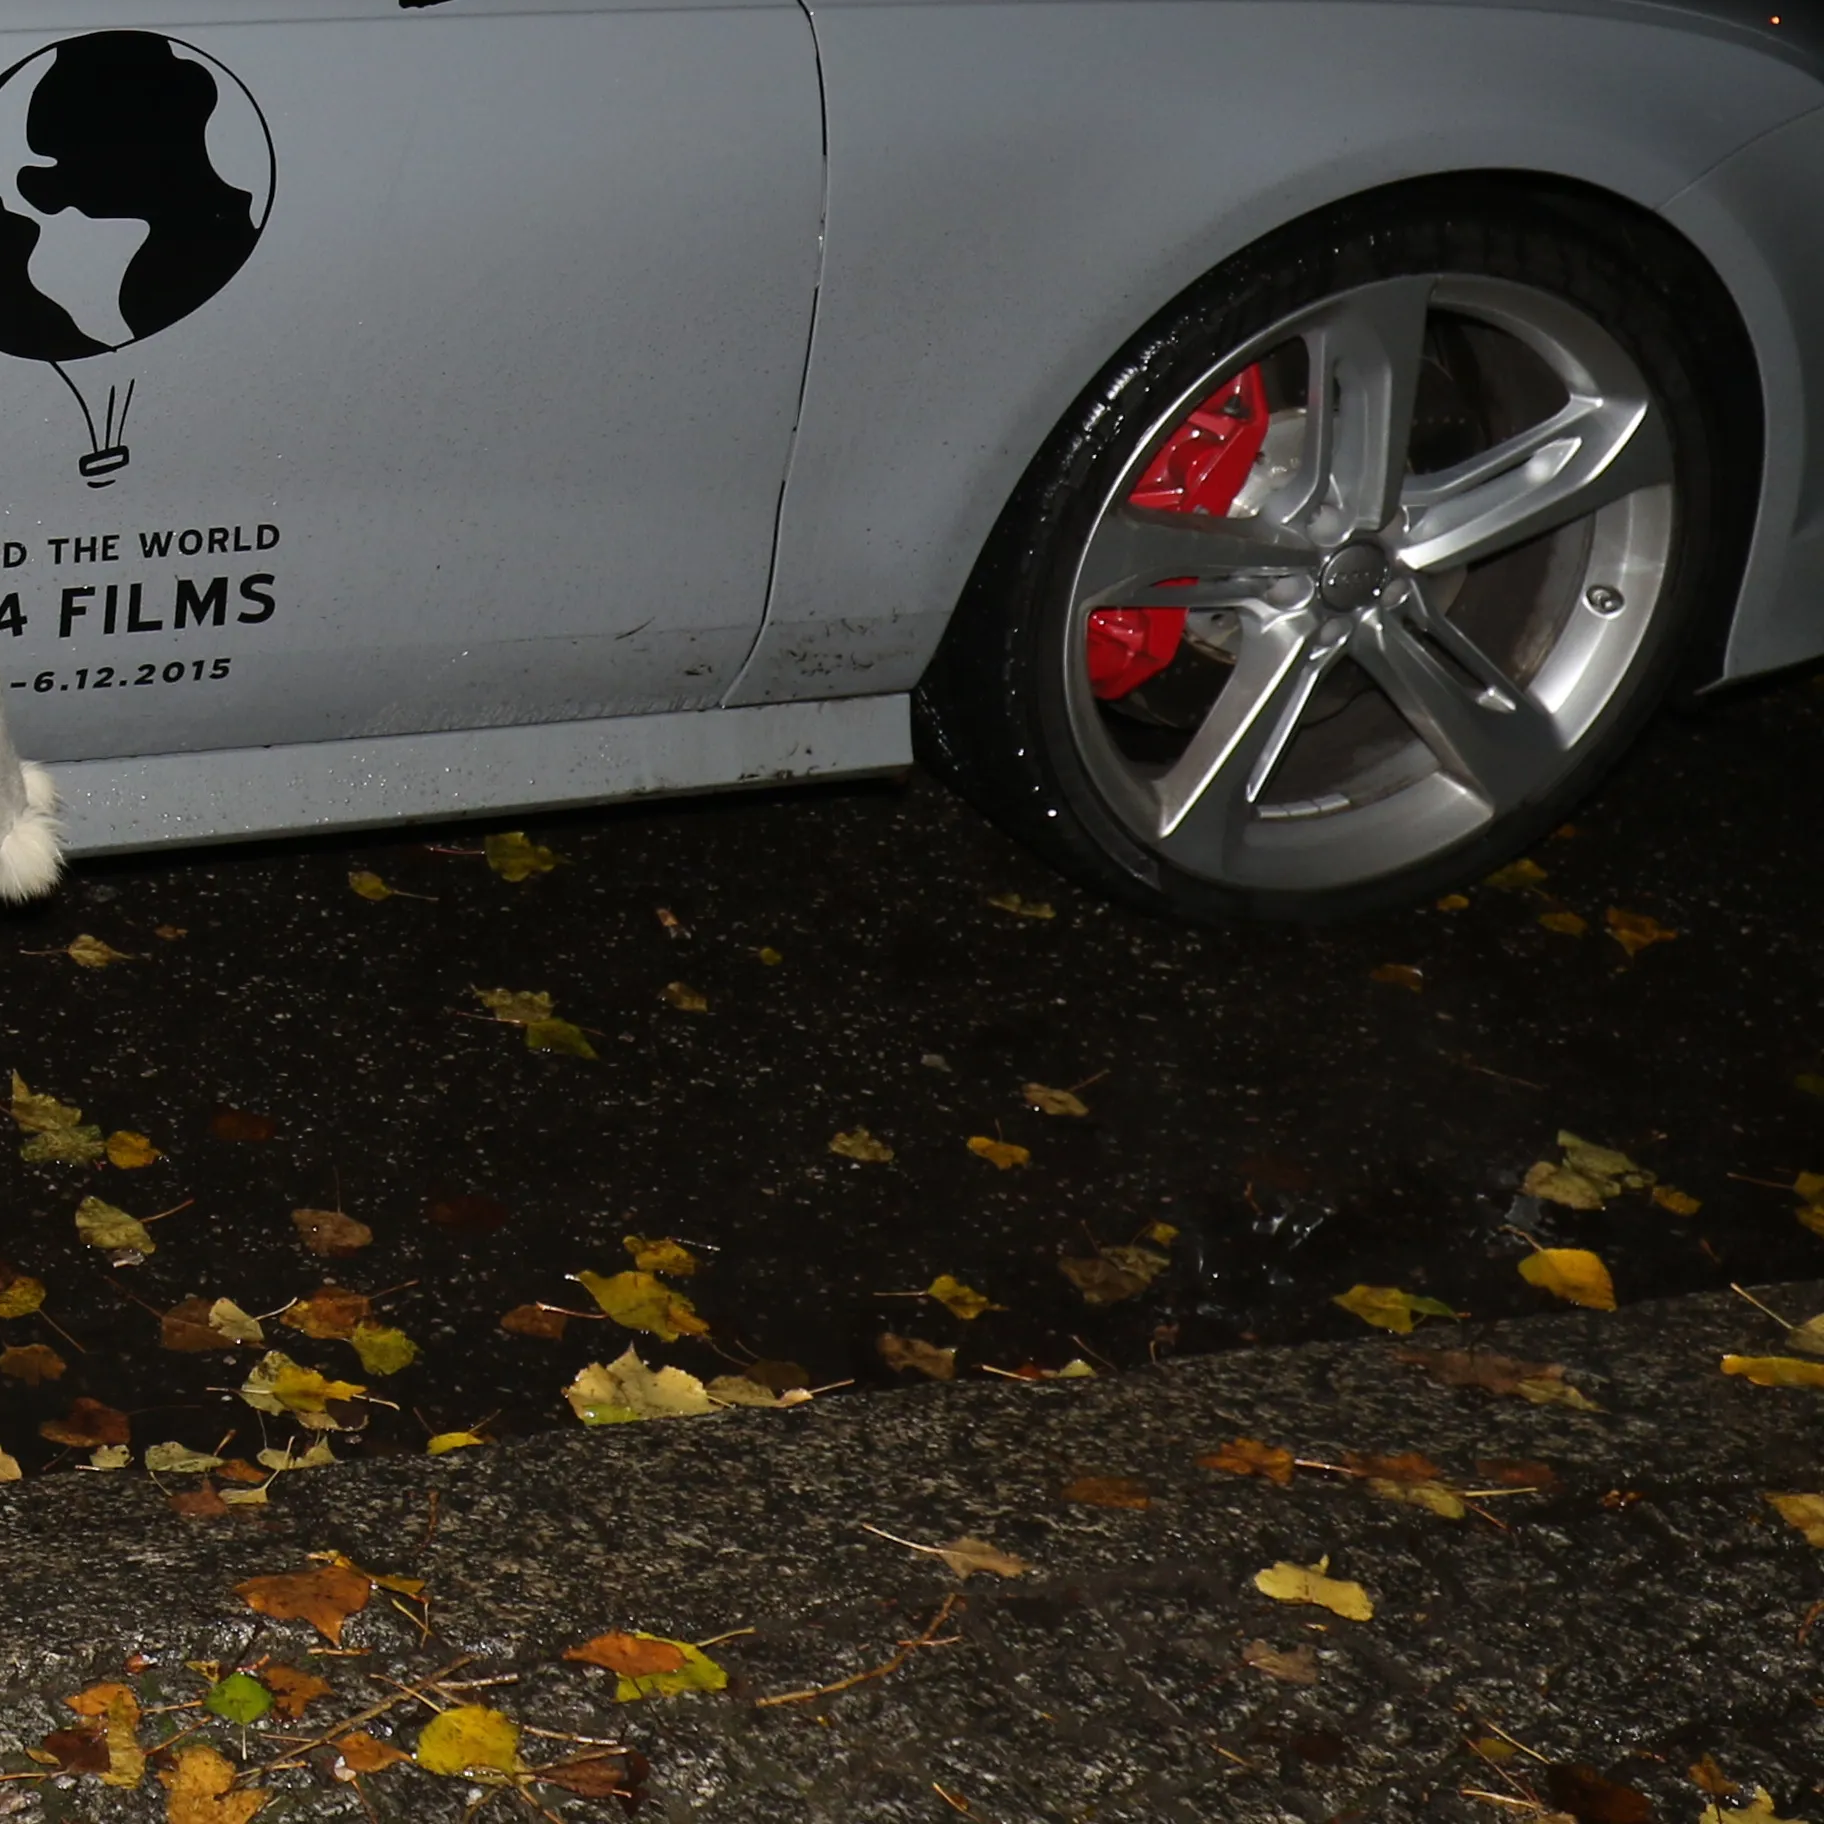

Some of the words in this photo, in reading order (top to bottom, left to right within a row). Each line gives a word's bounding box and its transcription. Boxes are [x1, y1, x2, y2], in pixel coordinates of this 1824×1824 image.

[47, 534, 121, 565] THE
[138, 523, 281, 559] WORLD
[58, 573, 276, 638] FILMS
